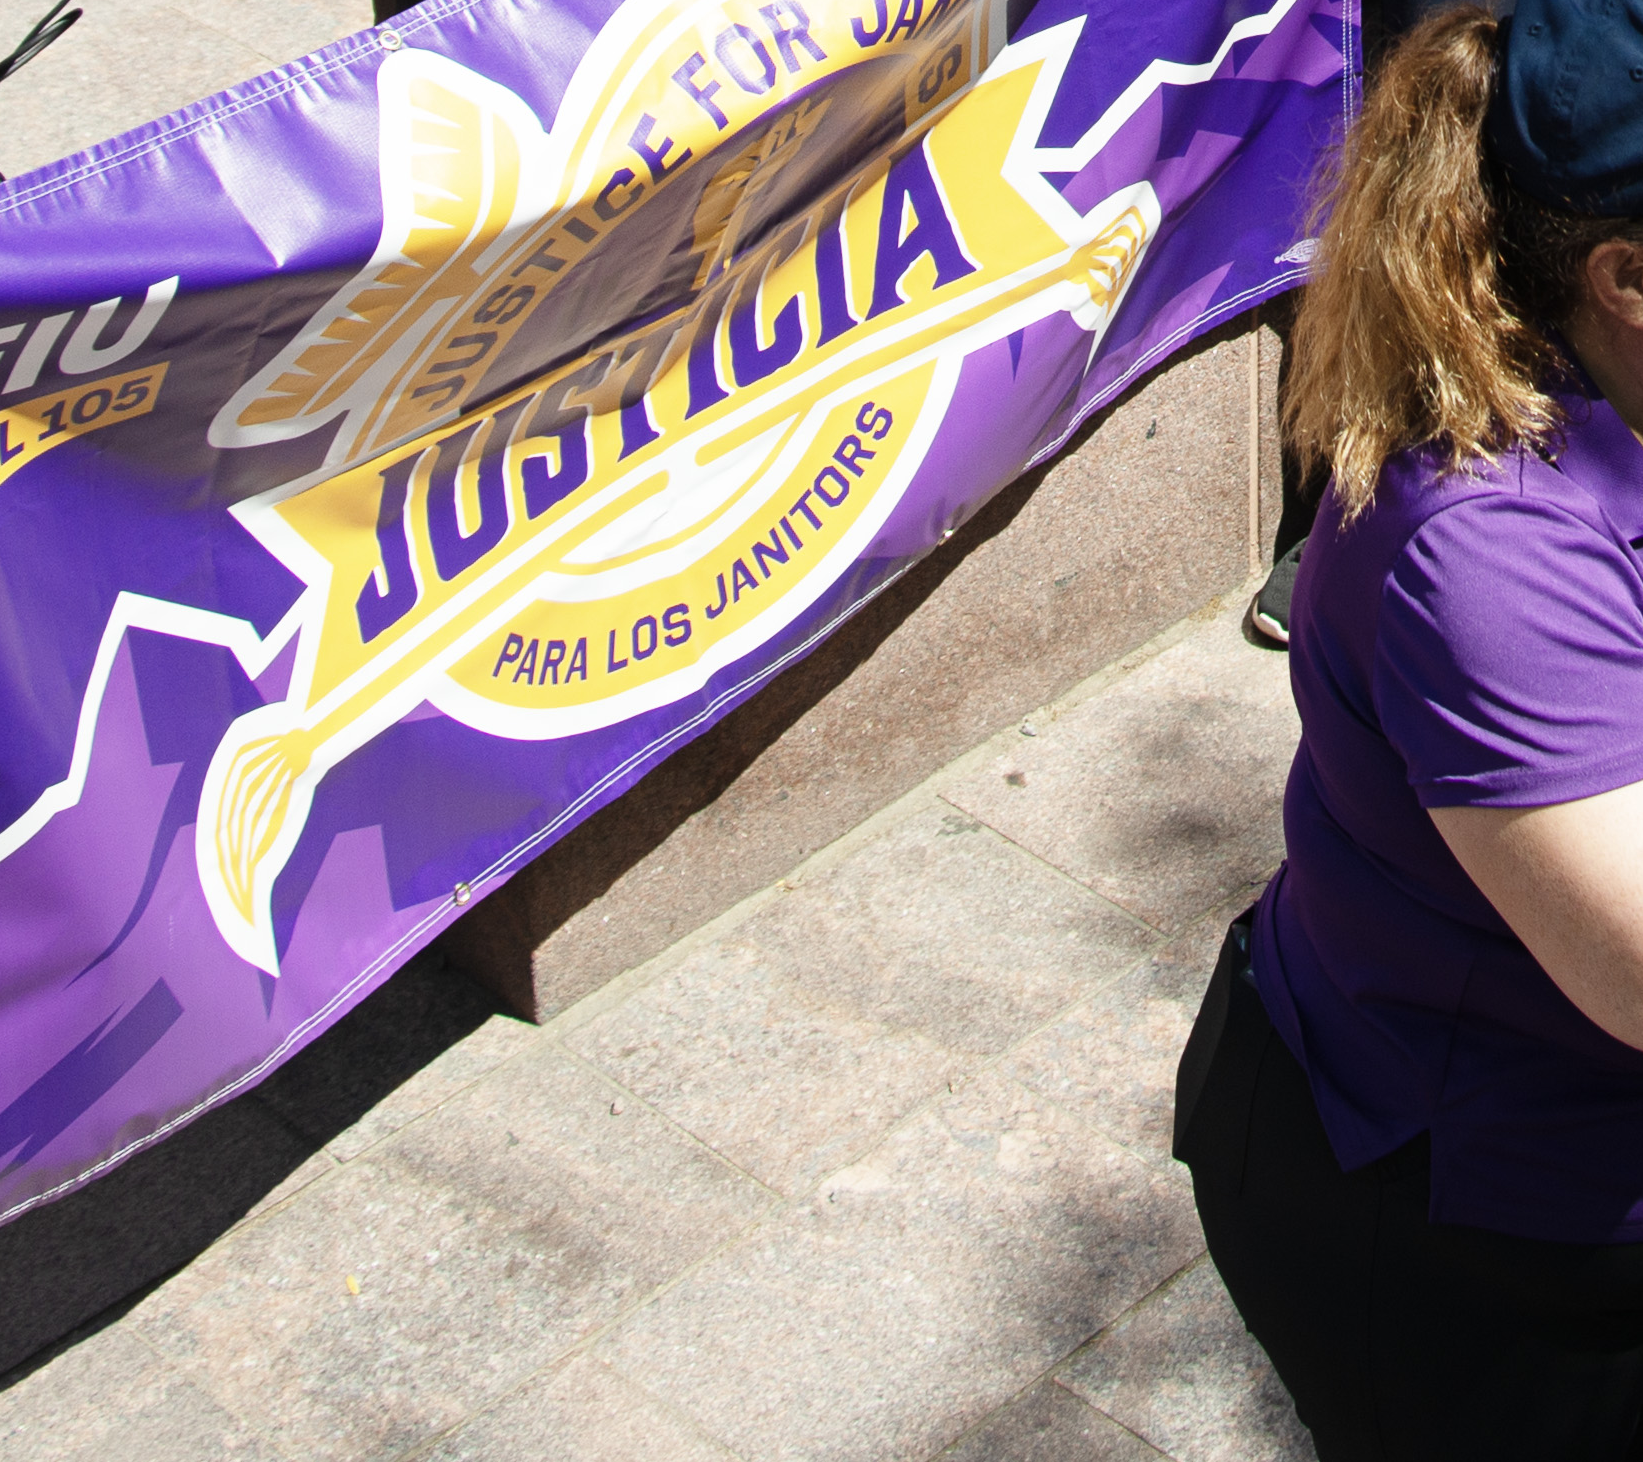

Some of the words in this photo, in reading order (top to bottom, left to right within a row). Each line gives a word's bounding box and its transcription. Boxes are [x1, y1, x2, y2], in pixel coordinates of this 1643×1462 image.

[35, 374, 153, 443] 105
[351, 138, 981, 649] JUSTICIA
[404, 126, 693, 412] JUSTICE
[493, 630, 592, 687] PARA
[605, 603, 692, 683] LOS
[703, 401, 895, 623] JANITORS
